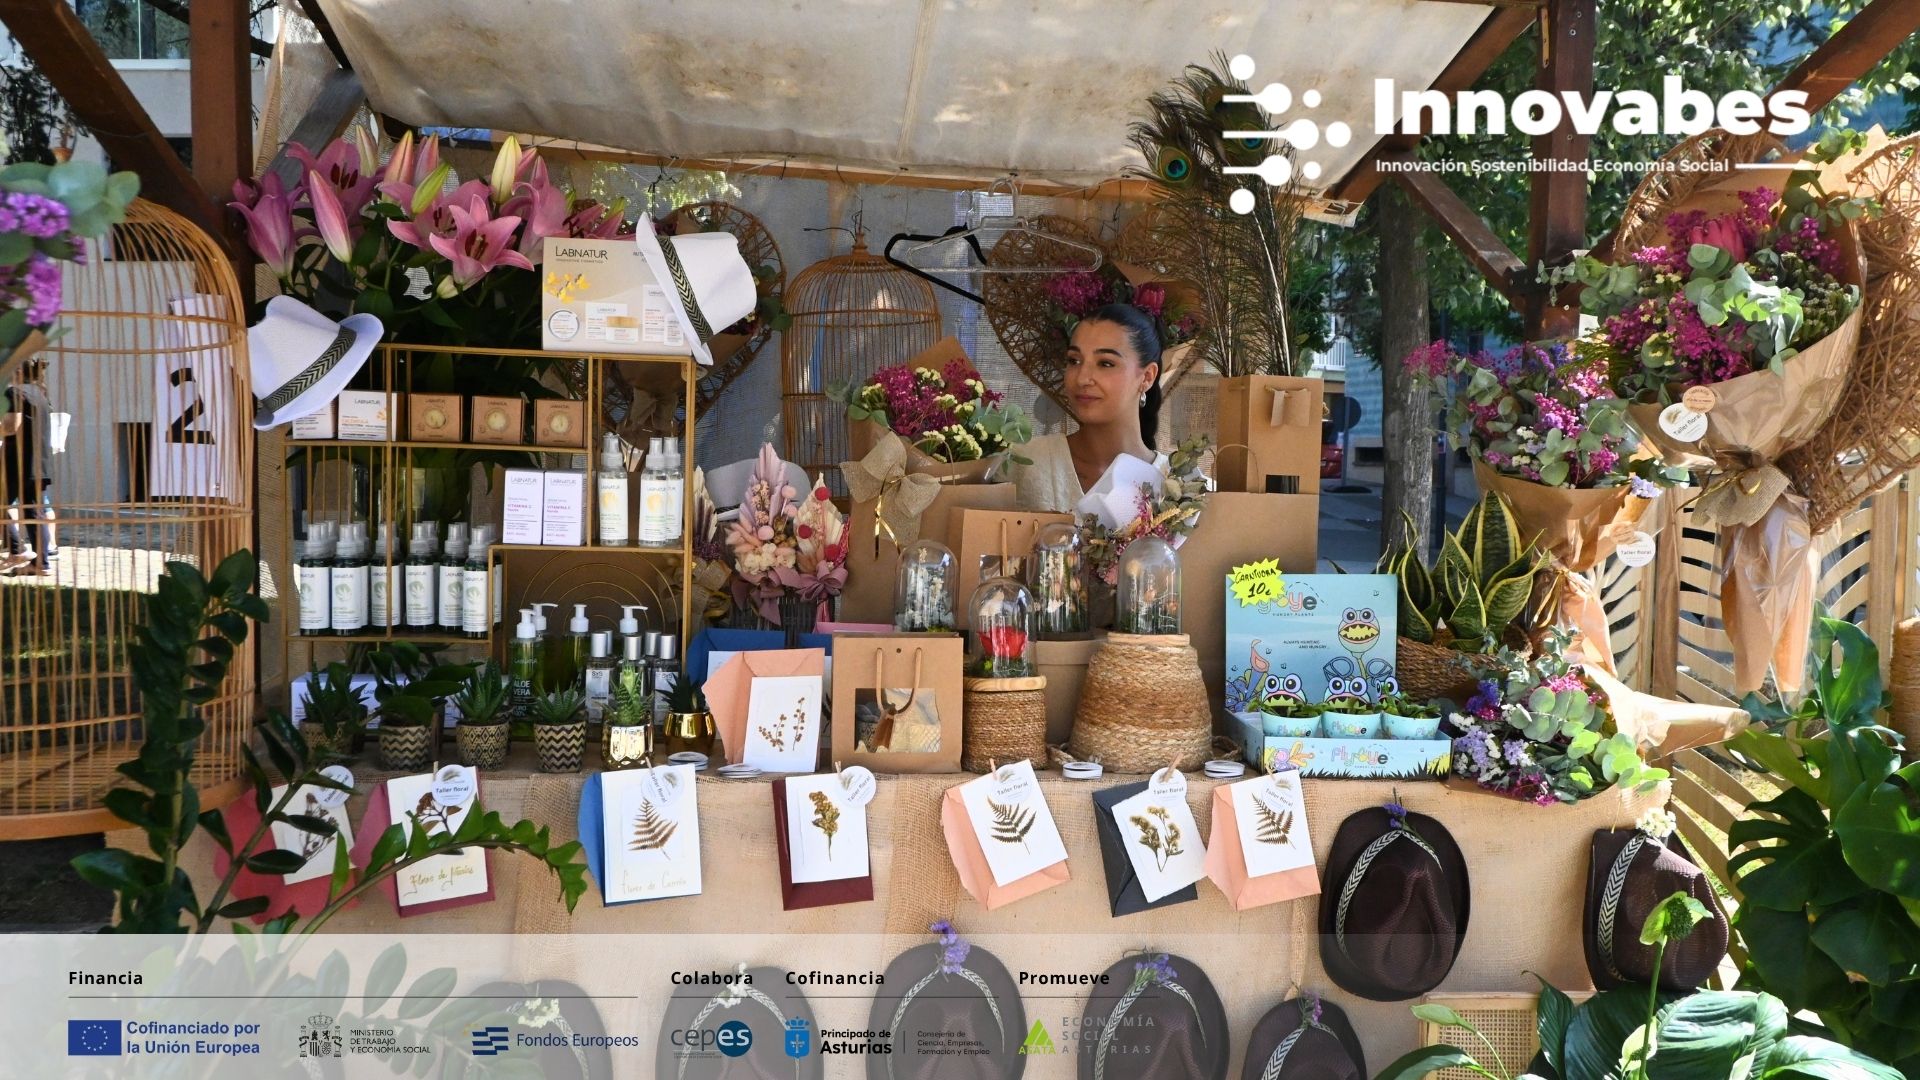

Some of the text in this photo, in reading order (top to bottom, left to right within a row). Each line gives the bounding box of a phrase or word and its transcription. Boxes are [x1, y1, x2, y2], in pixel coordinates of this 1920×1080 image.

[555, 245, 608, 260] LABNATUR
[165, 367, 216, 445] 2
[513, 680, 531, 688] ALOE
[513, 688, 531, 696] VERA
[436, 786, 453, 794] Taller
[997, 787, 1013, 796] Taller
